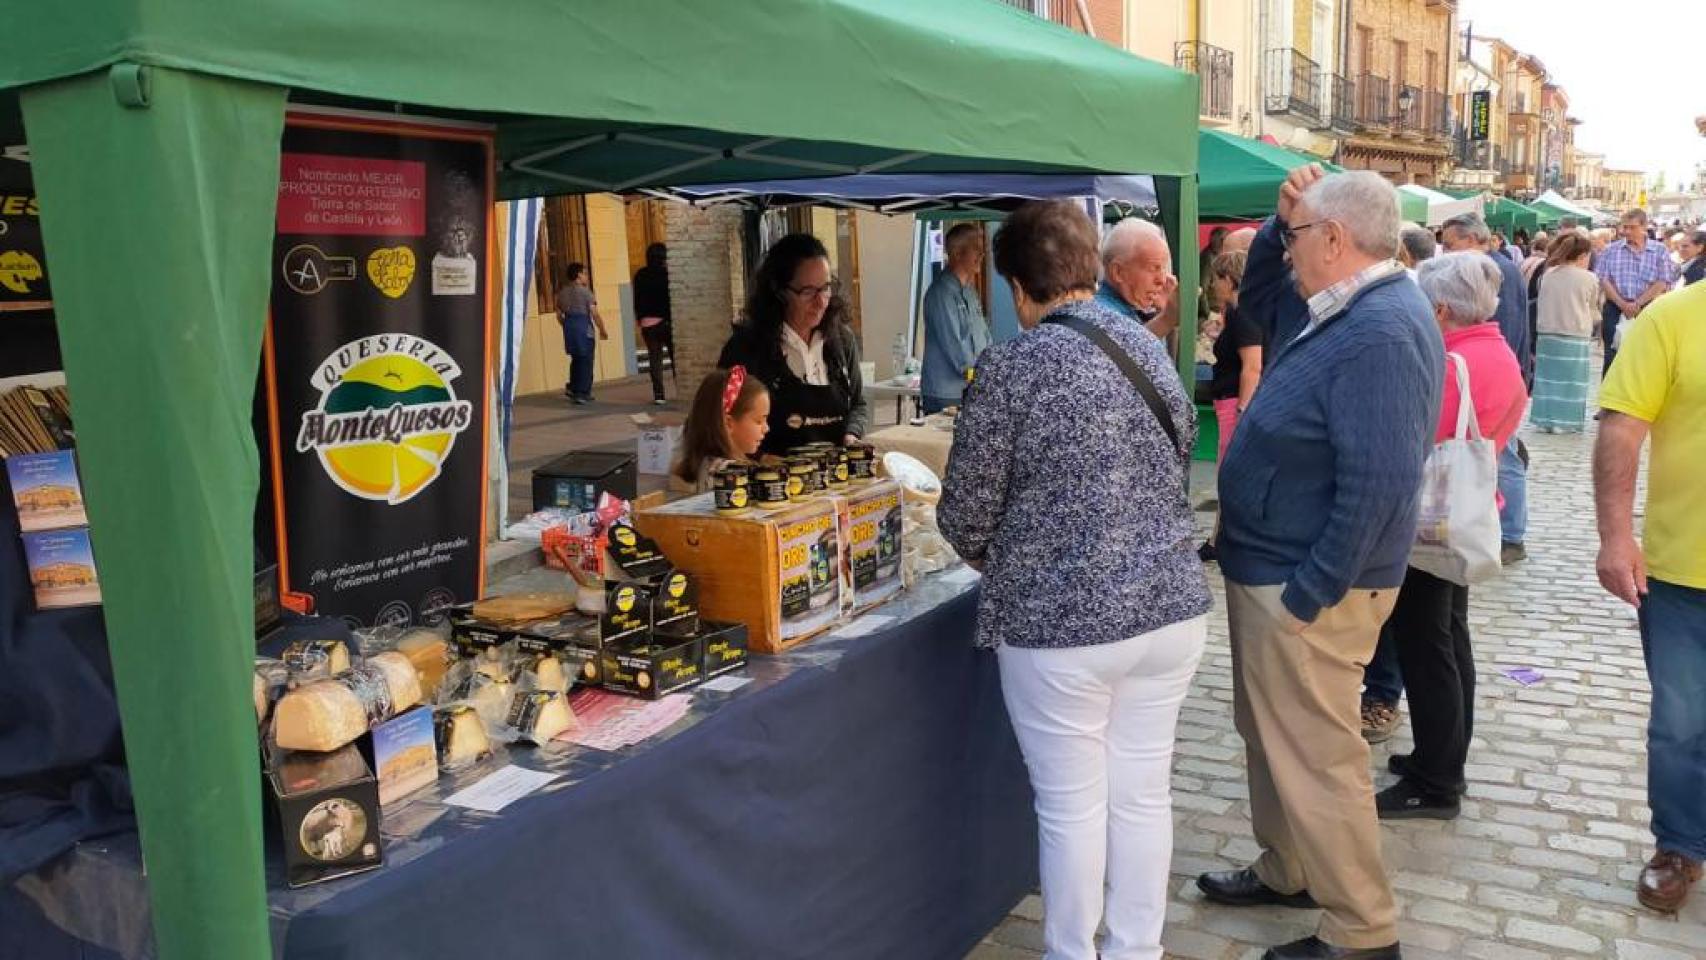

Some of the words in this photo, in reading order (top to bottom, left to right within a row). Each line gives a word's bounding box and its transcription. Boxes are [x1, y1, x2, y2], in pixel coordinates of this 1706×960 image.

[298, 167, 360, 182] Nombrado
[363, 171, 405, 185] MEJOR
[279, 181, 354, 197] PRODUCTO
[357, 185, 421, 200] ARTESANO
[310, 196, 344, 210] Tierra
[346, 199, 362, 211] de
[365, 199, 397, 211] Sabor
[304, 211, 320, 223] de
[322, 211, 363, 225] Castilla
[366, 215, 375, 227] y
[323, 336, 453, 386] QUESERIA
[301, 403, 470, 449] MonteQuesos
[849, 520, 876, 545] ORO
[782, 543, 808, 571] ORO
